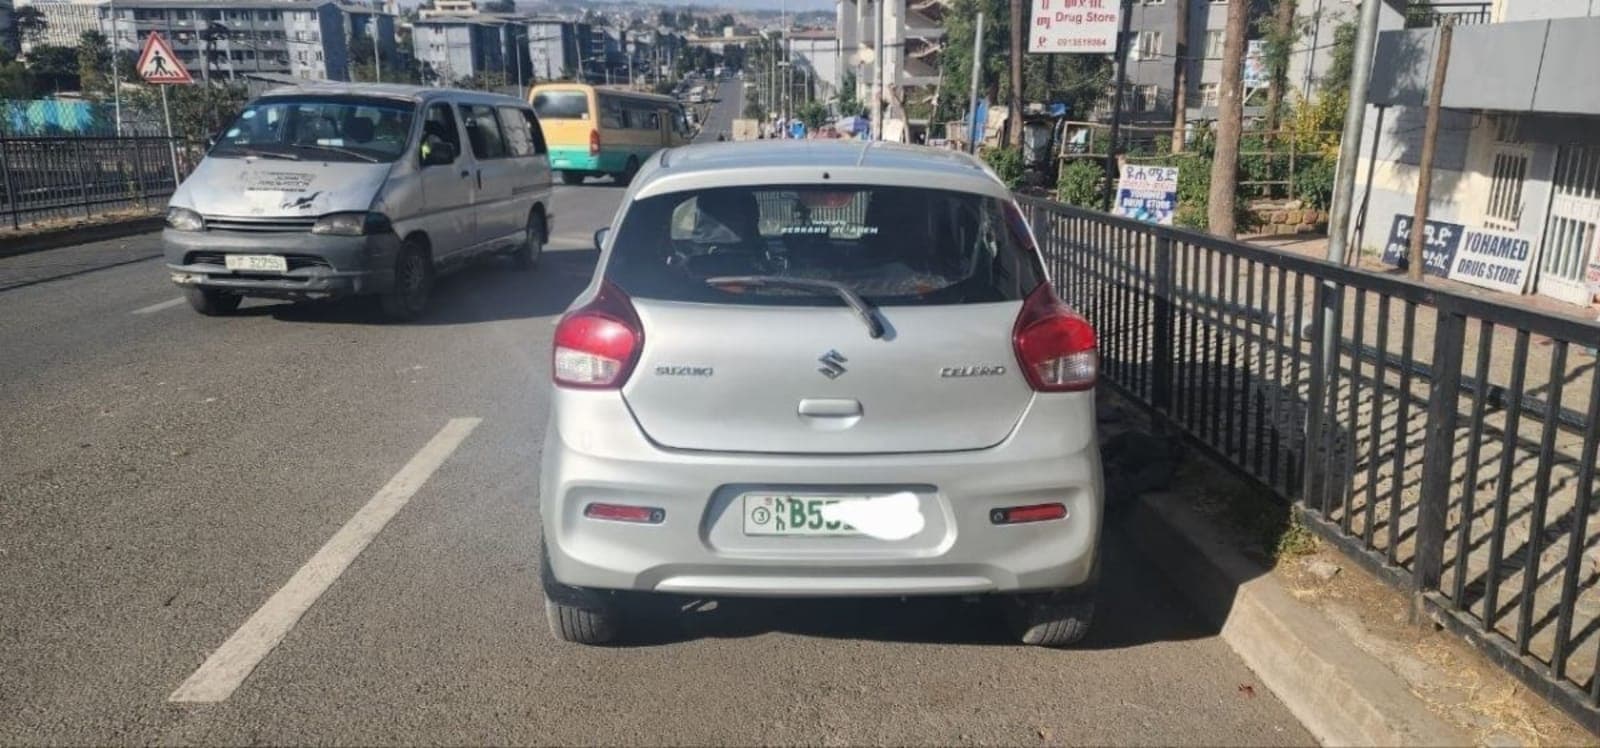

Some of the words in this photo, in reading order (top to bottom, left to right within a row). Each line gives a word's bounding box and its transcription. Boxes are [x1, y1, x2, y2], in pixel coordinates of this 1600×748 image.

[1055, 11, 1082, 24] Drug
[1086, 11, 1116, 22] Store
[1464, 231, 1530, 262] YOHAMED
[1457, 257, 1487, 279] DRUG
[1486, 263, 1523, 285] STORE
[655, 366, 714, 377] SUZUKI
[940, 366, 1006, 378] CELERIO
